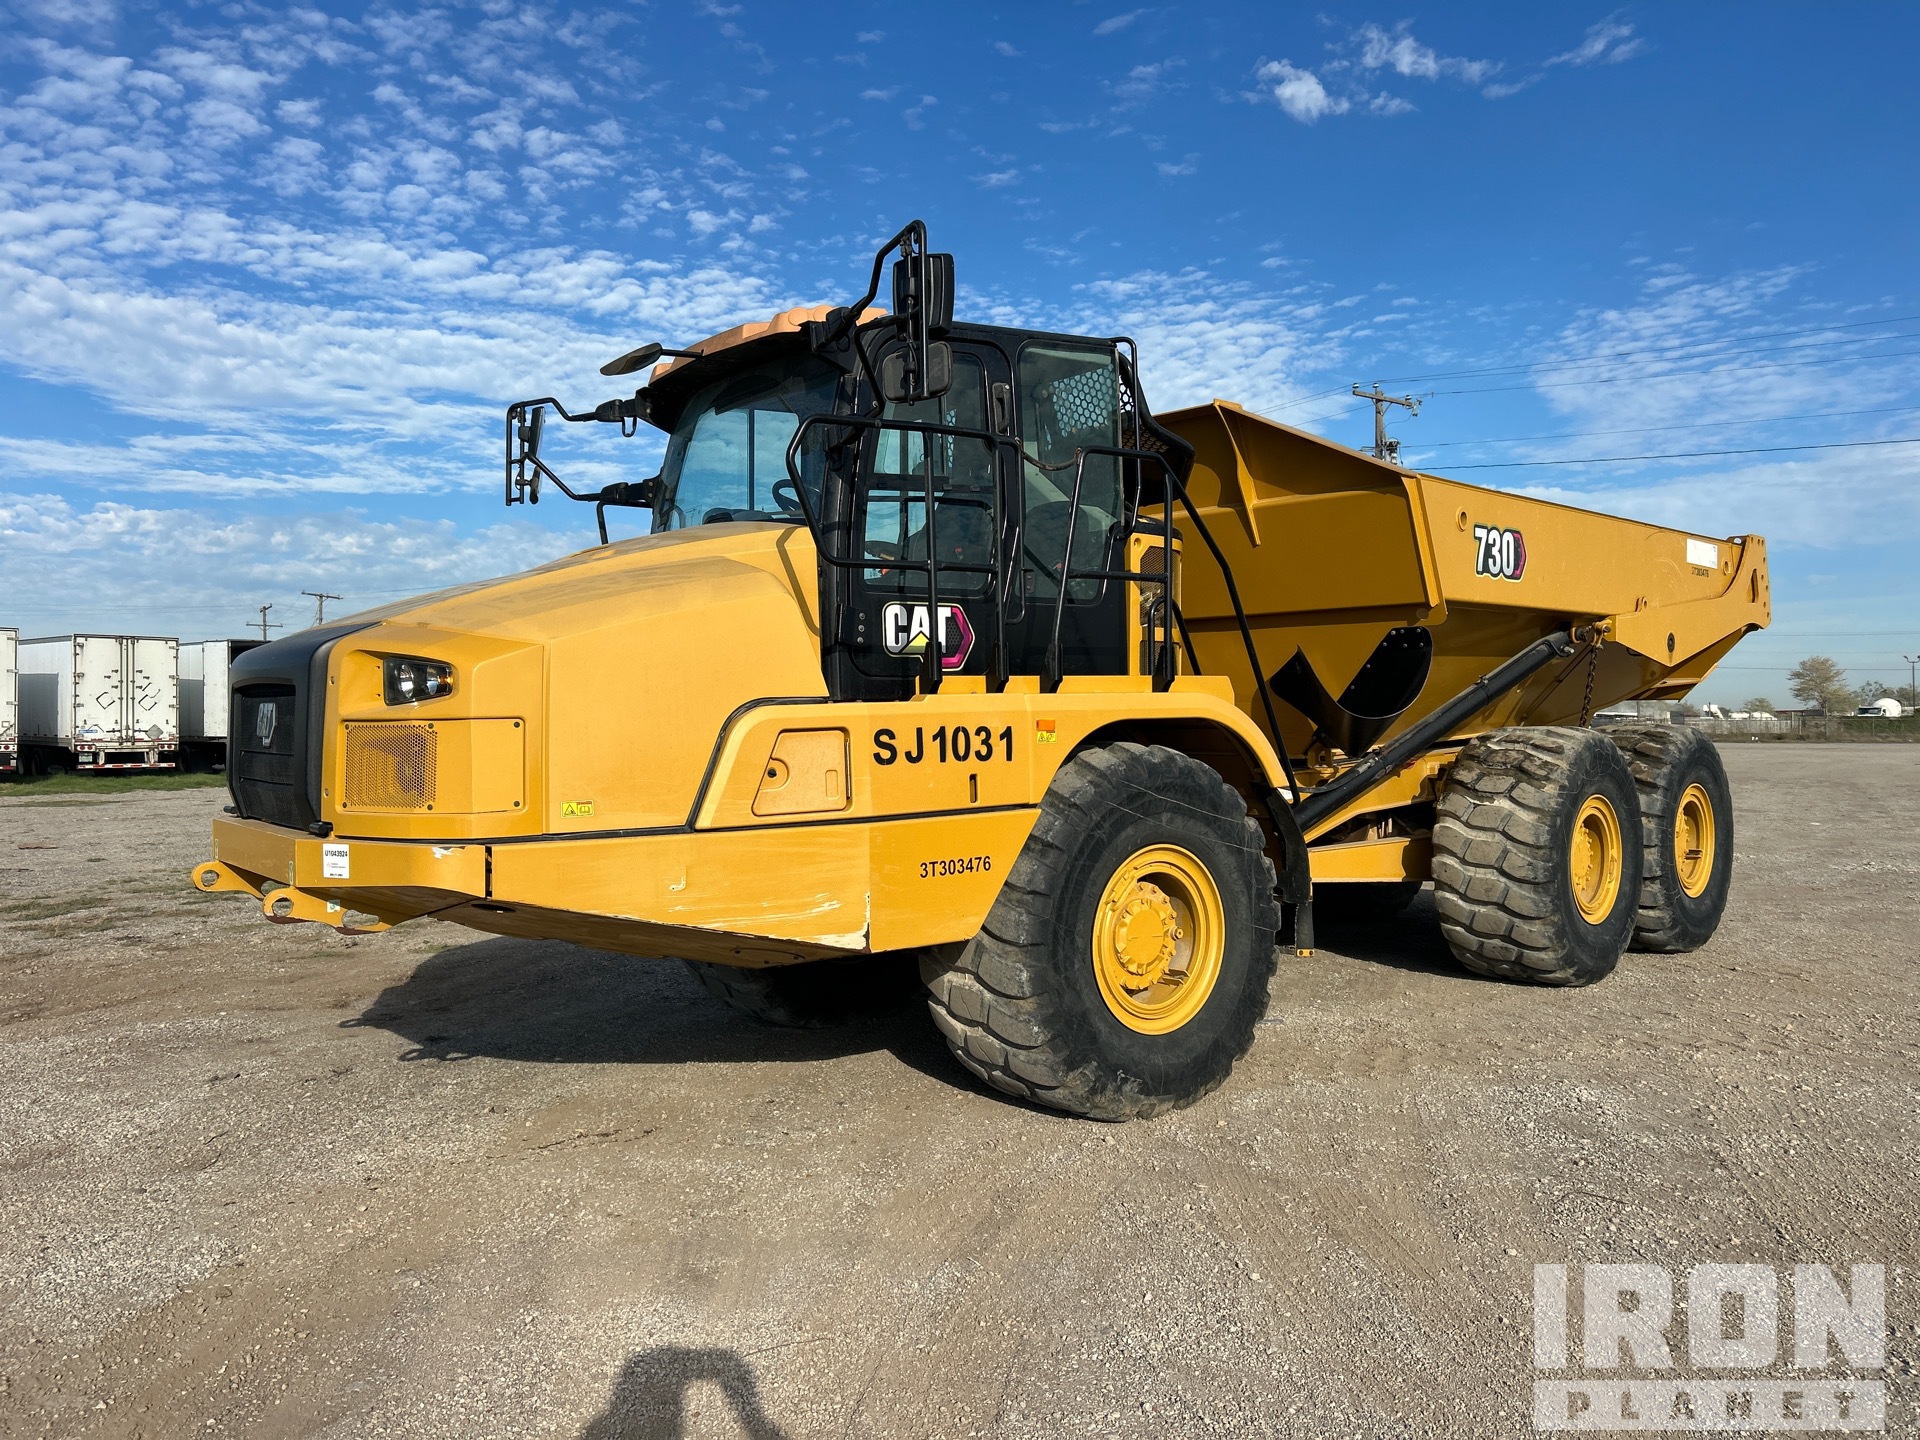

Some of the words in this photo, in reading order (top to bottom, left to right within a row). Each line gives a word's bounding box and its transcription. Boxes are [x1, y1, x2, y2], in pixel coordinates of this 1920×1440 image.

[1474, 527, 1515, 576] 730
[885, 604, 952, 654] CAT
[873, 725, 1013, 766] SJ1031
[324, 849, 348, 857] U1043924
[920, 855, 992, 879] 3T303476
